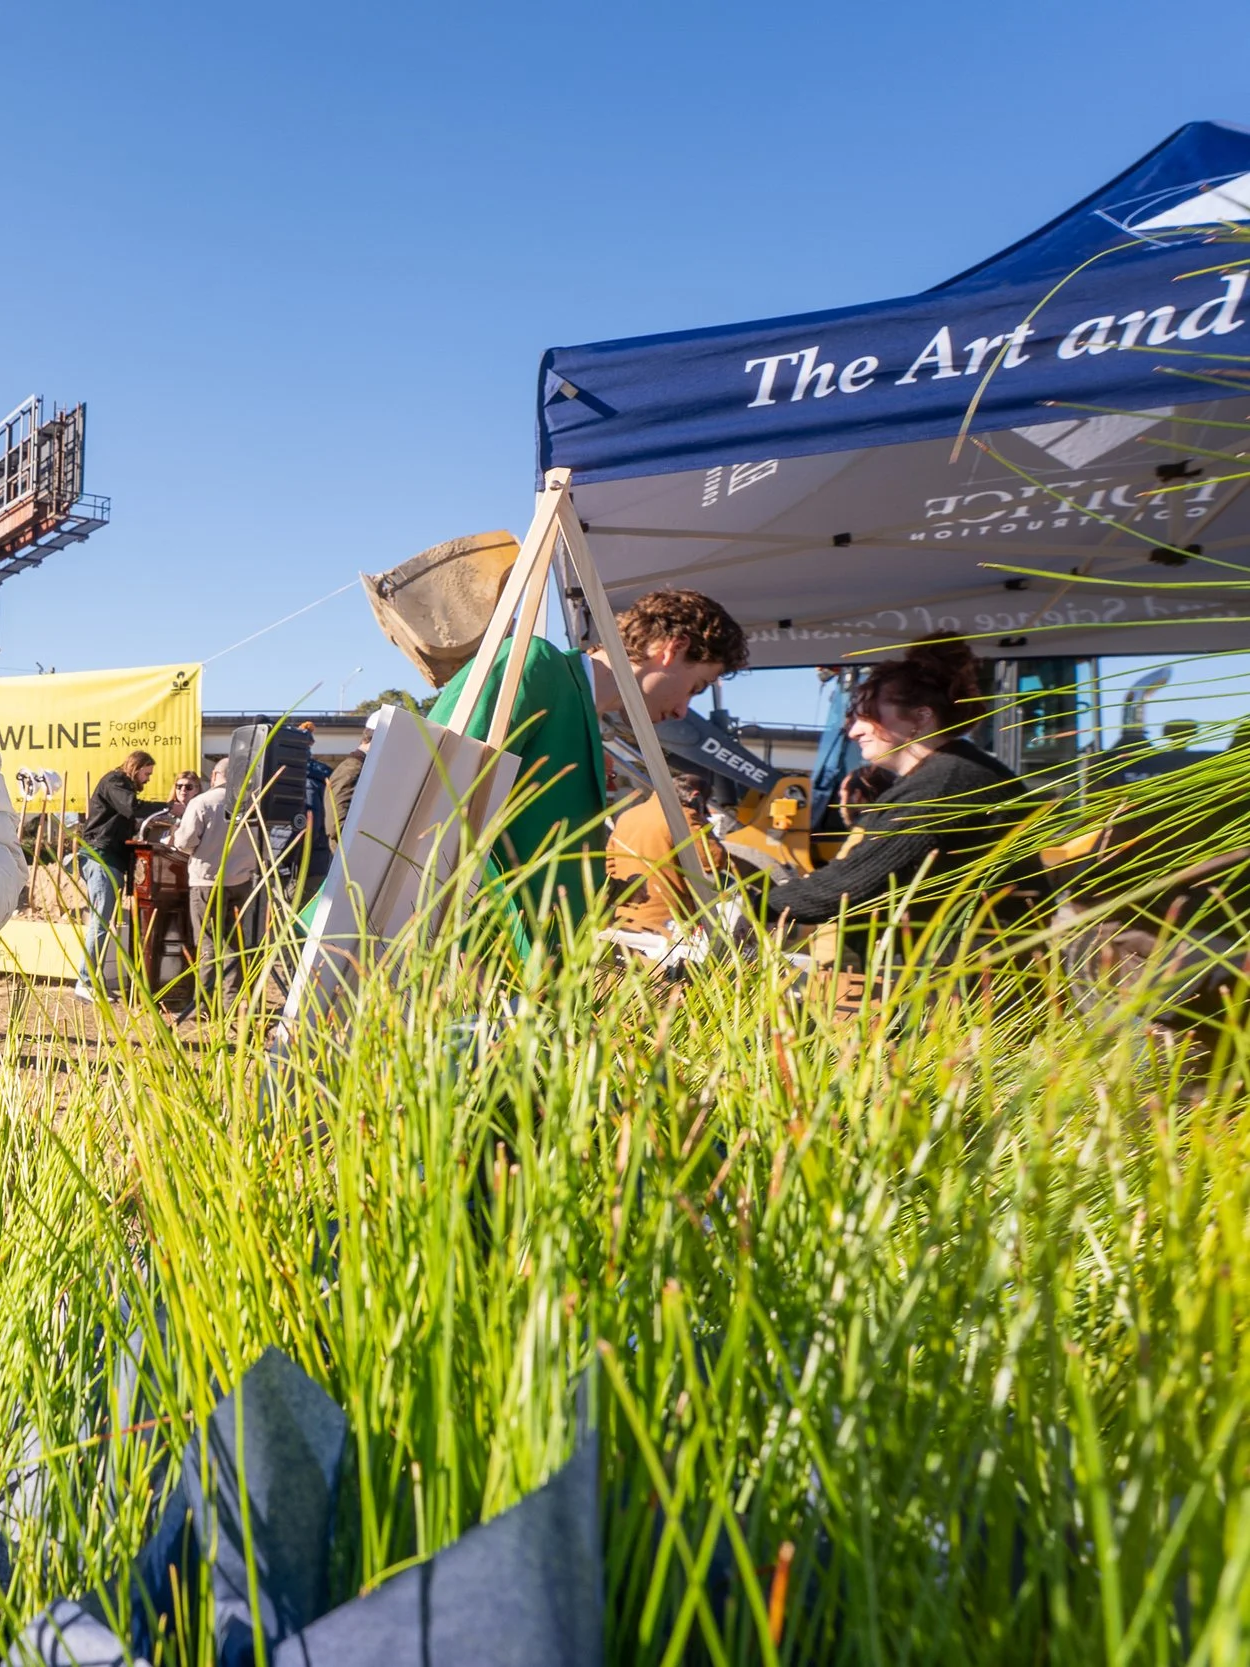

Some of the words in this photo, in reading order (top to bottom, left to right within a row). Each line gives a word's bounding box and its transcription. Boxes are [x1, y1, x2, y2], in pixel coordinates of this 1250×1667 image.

[744, 345, 879, 408] The
[894, 322, 1035, 386] Art
[1057, 269, 1250, 360] and
[109, 719, 157, 733] Forging
[109, 737, 118, 747] A
[121, 736, 150, 747] New
[153, 734, 182, 746] Path
[700, 736, 769, 784] DEERE
